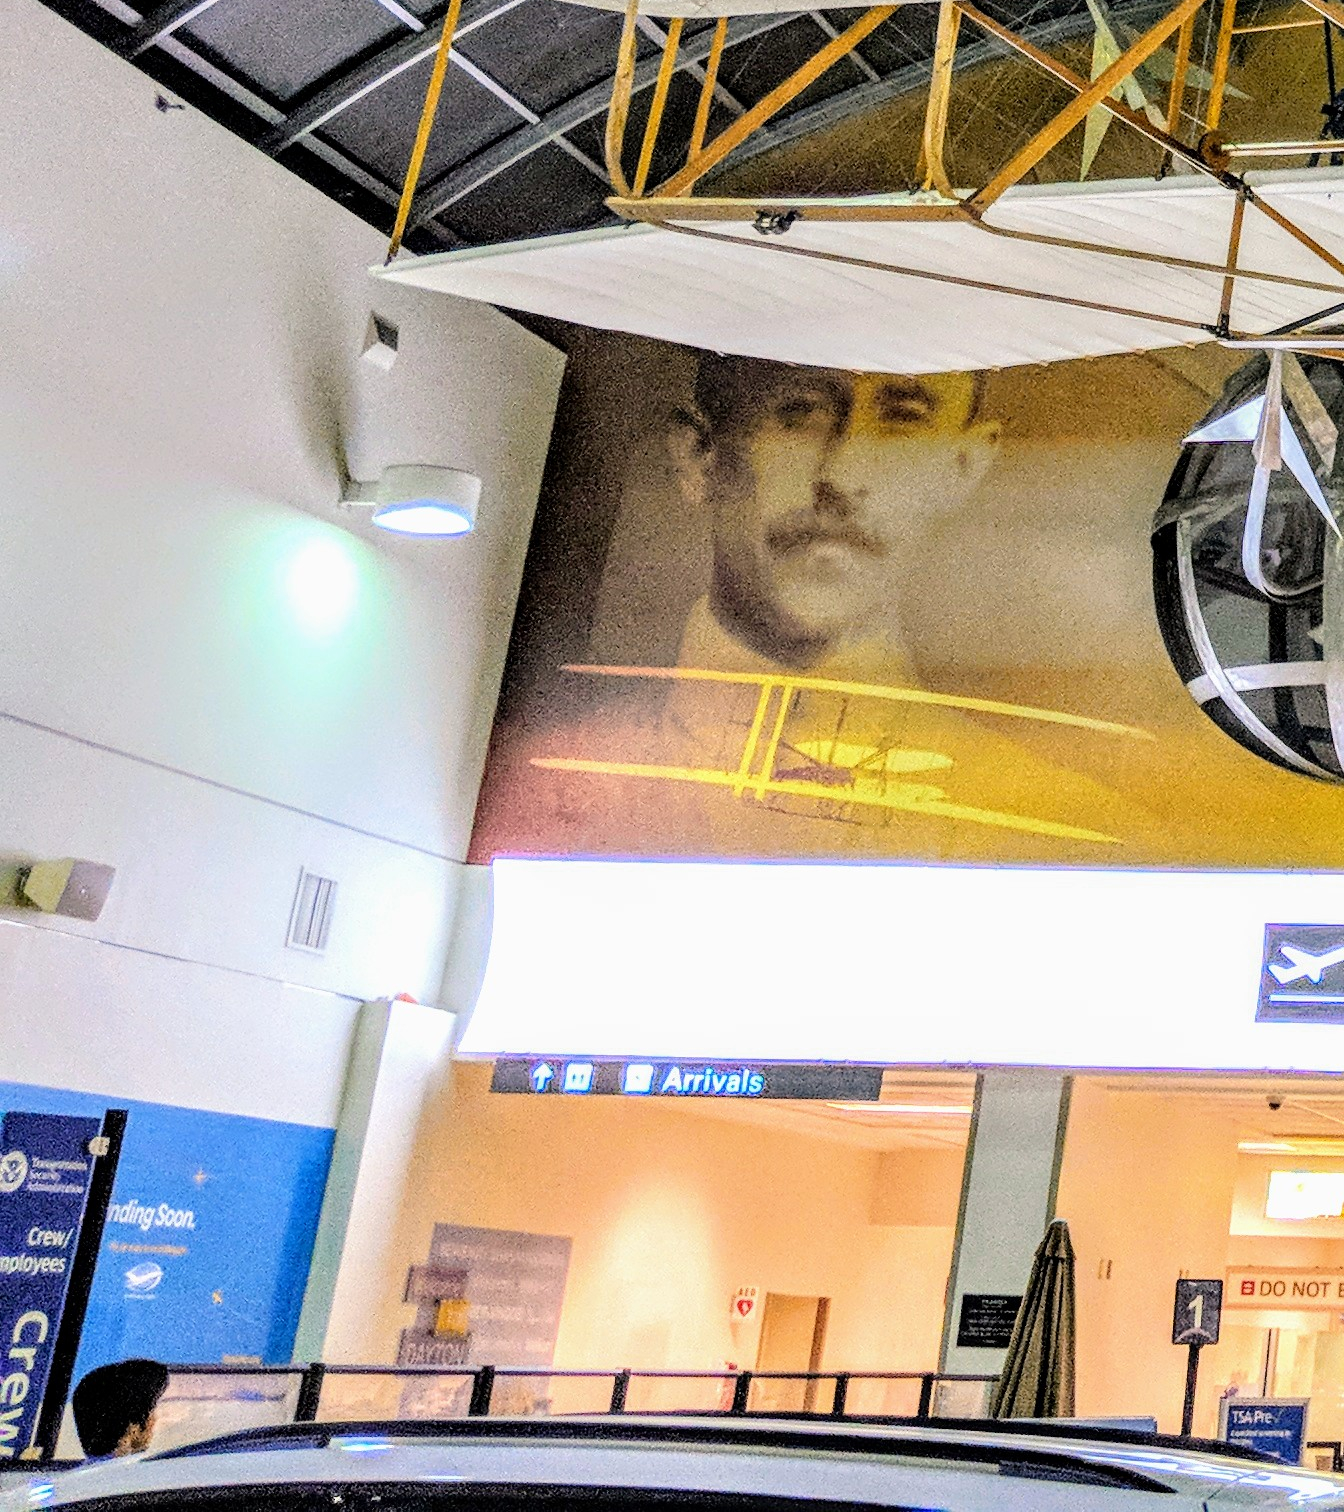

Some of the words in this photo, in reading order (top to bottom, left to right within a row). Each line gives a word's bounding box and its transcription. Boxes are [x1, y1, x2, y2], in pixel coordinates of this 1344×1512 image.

[660, 1066, 765, 1094] Arrivals
[156, 1203, 196, 1229] Soon.
[27, 1226, 74, 1249] Crew/
[1259, 1281, 1286, 1297] DO
[1292, 1281, 1331, 1298] NOT
[1189, 1294, 1204, 1327] 1
